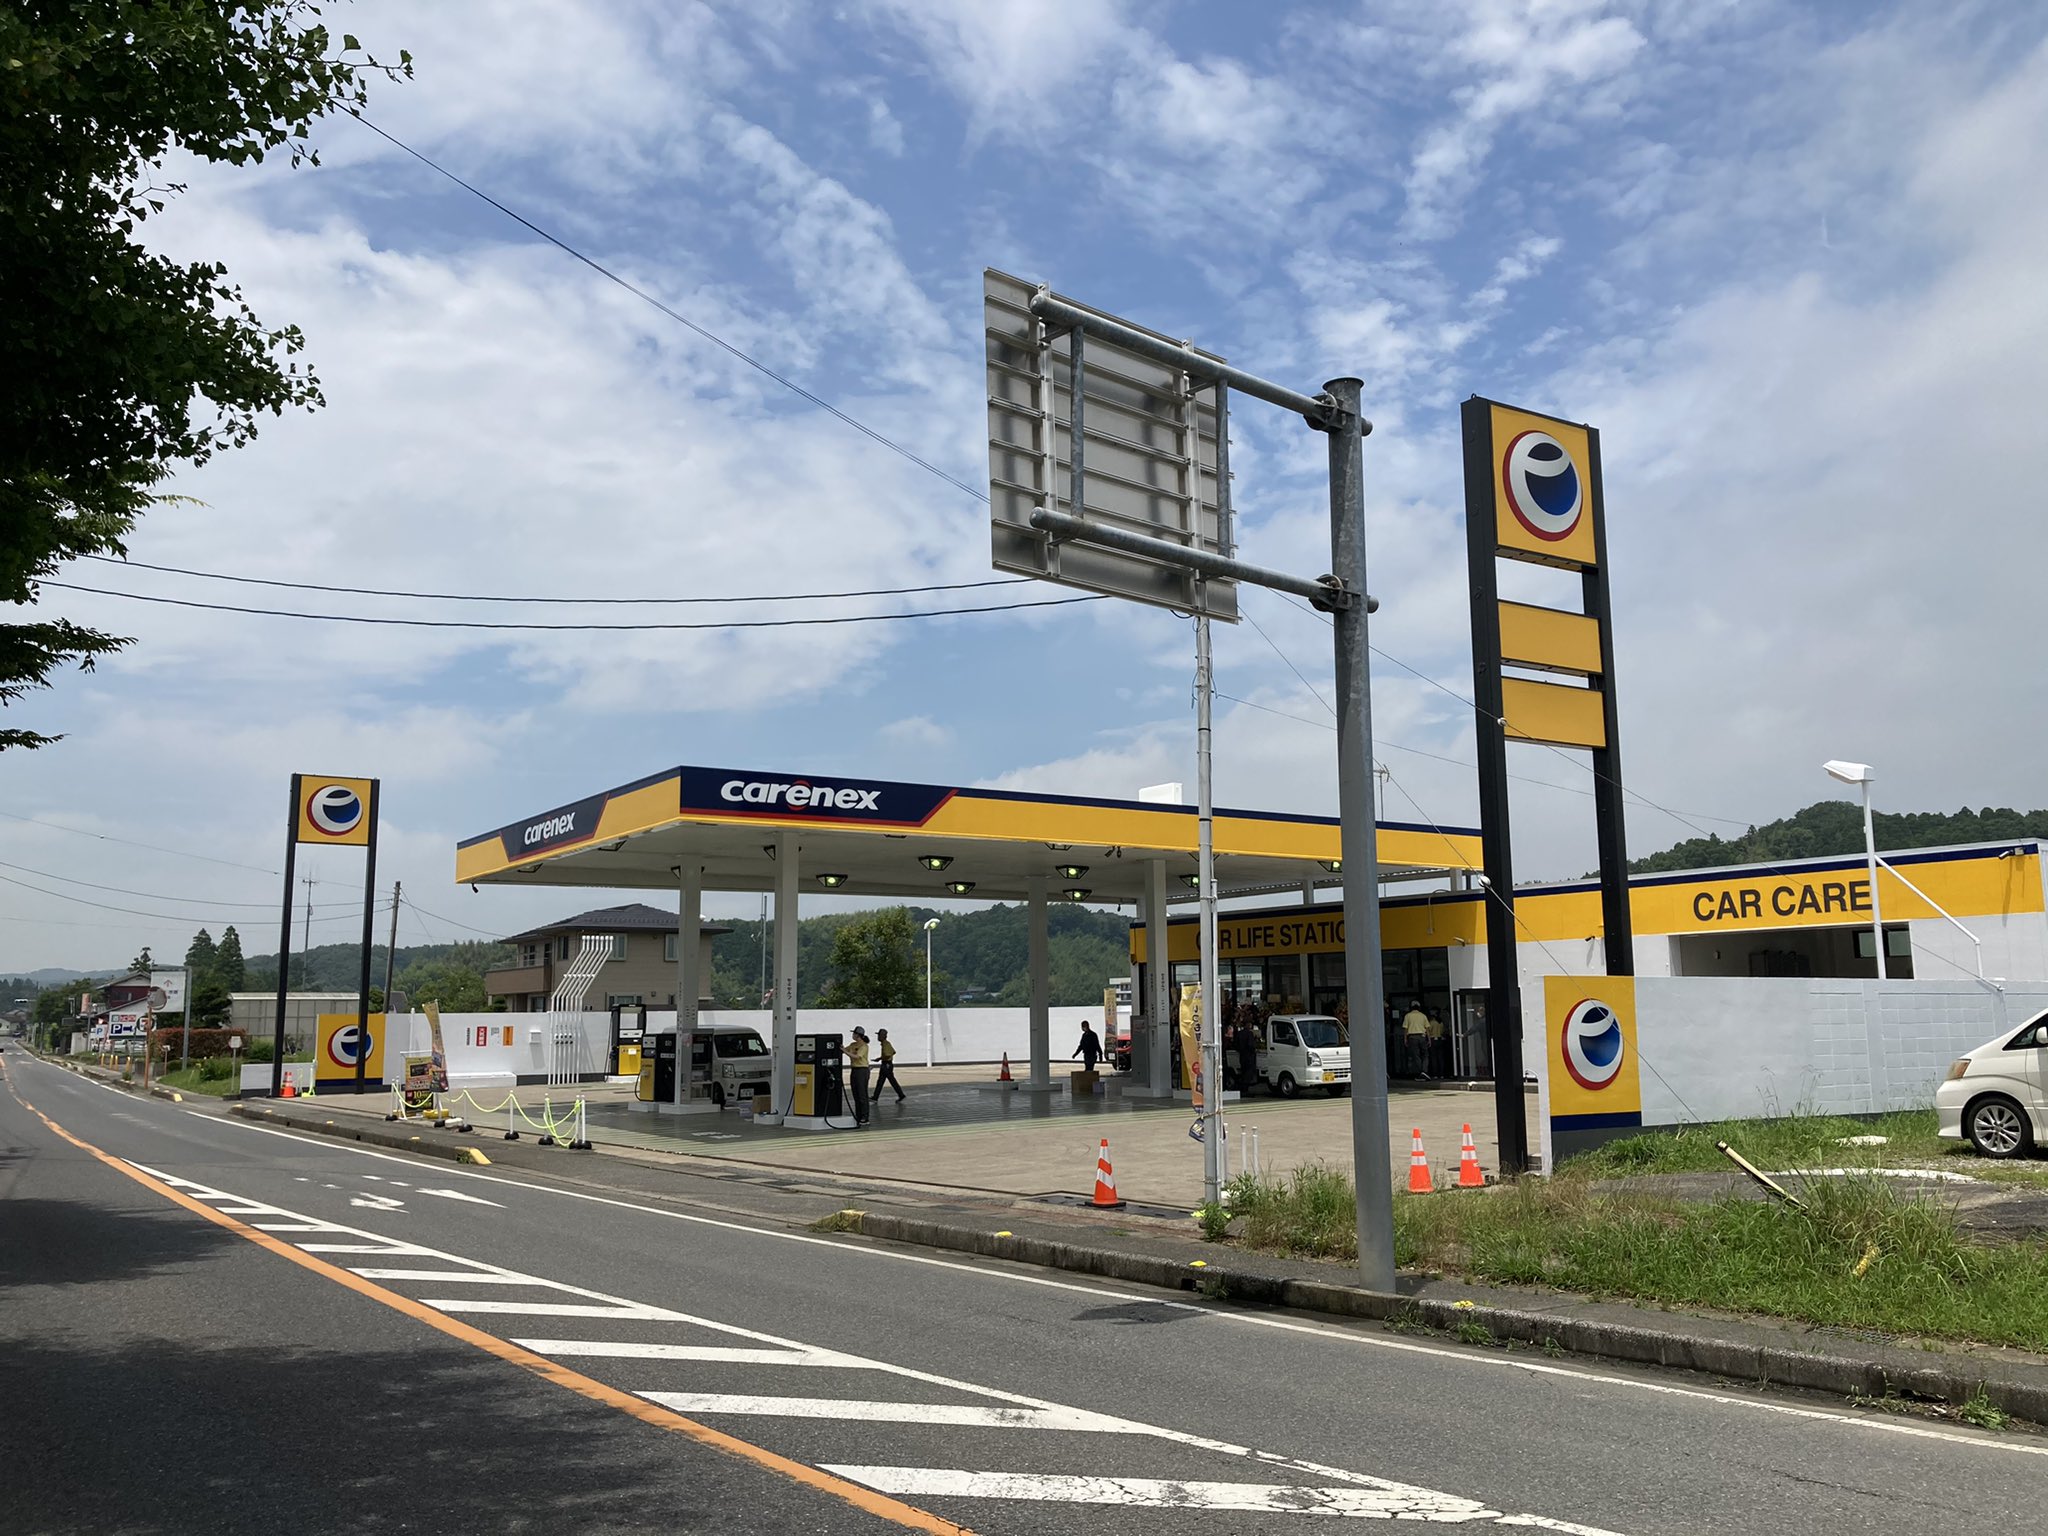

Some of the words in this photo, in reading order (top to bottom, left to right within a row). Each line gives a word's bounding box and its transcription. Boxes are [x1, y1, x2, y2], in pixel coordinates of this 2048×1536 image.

[720, 779, 881, 812] carenex
[523, 811, 575, 845] carenex
[1693, 888, 1762, 921] CAR
[1772, 880, 1873, 916] CARE
[1237, 926, 1275, 949] LIFE
[113, 1024, 121, 1034] P
